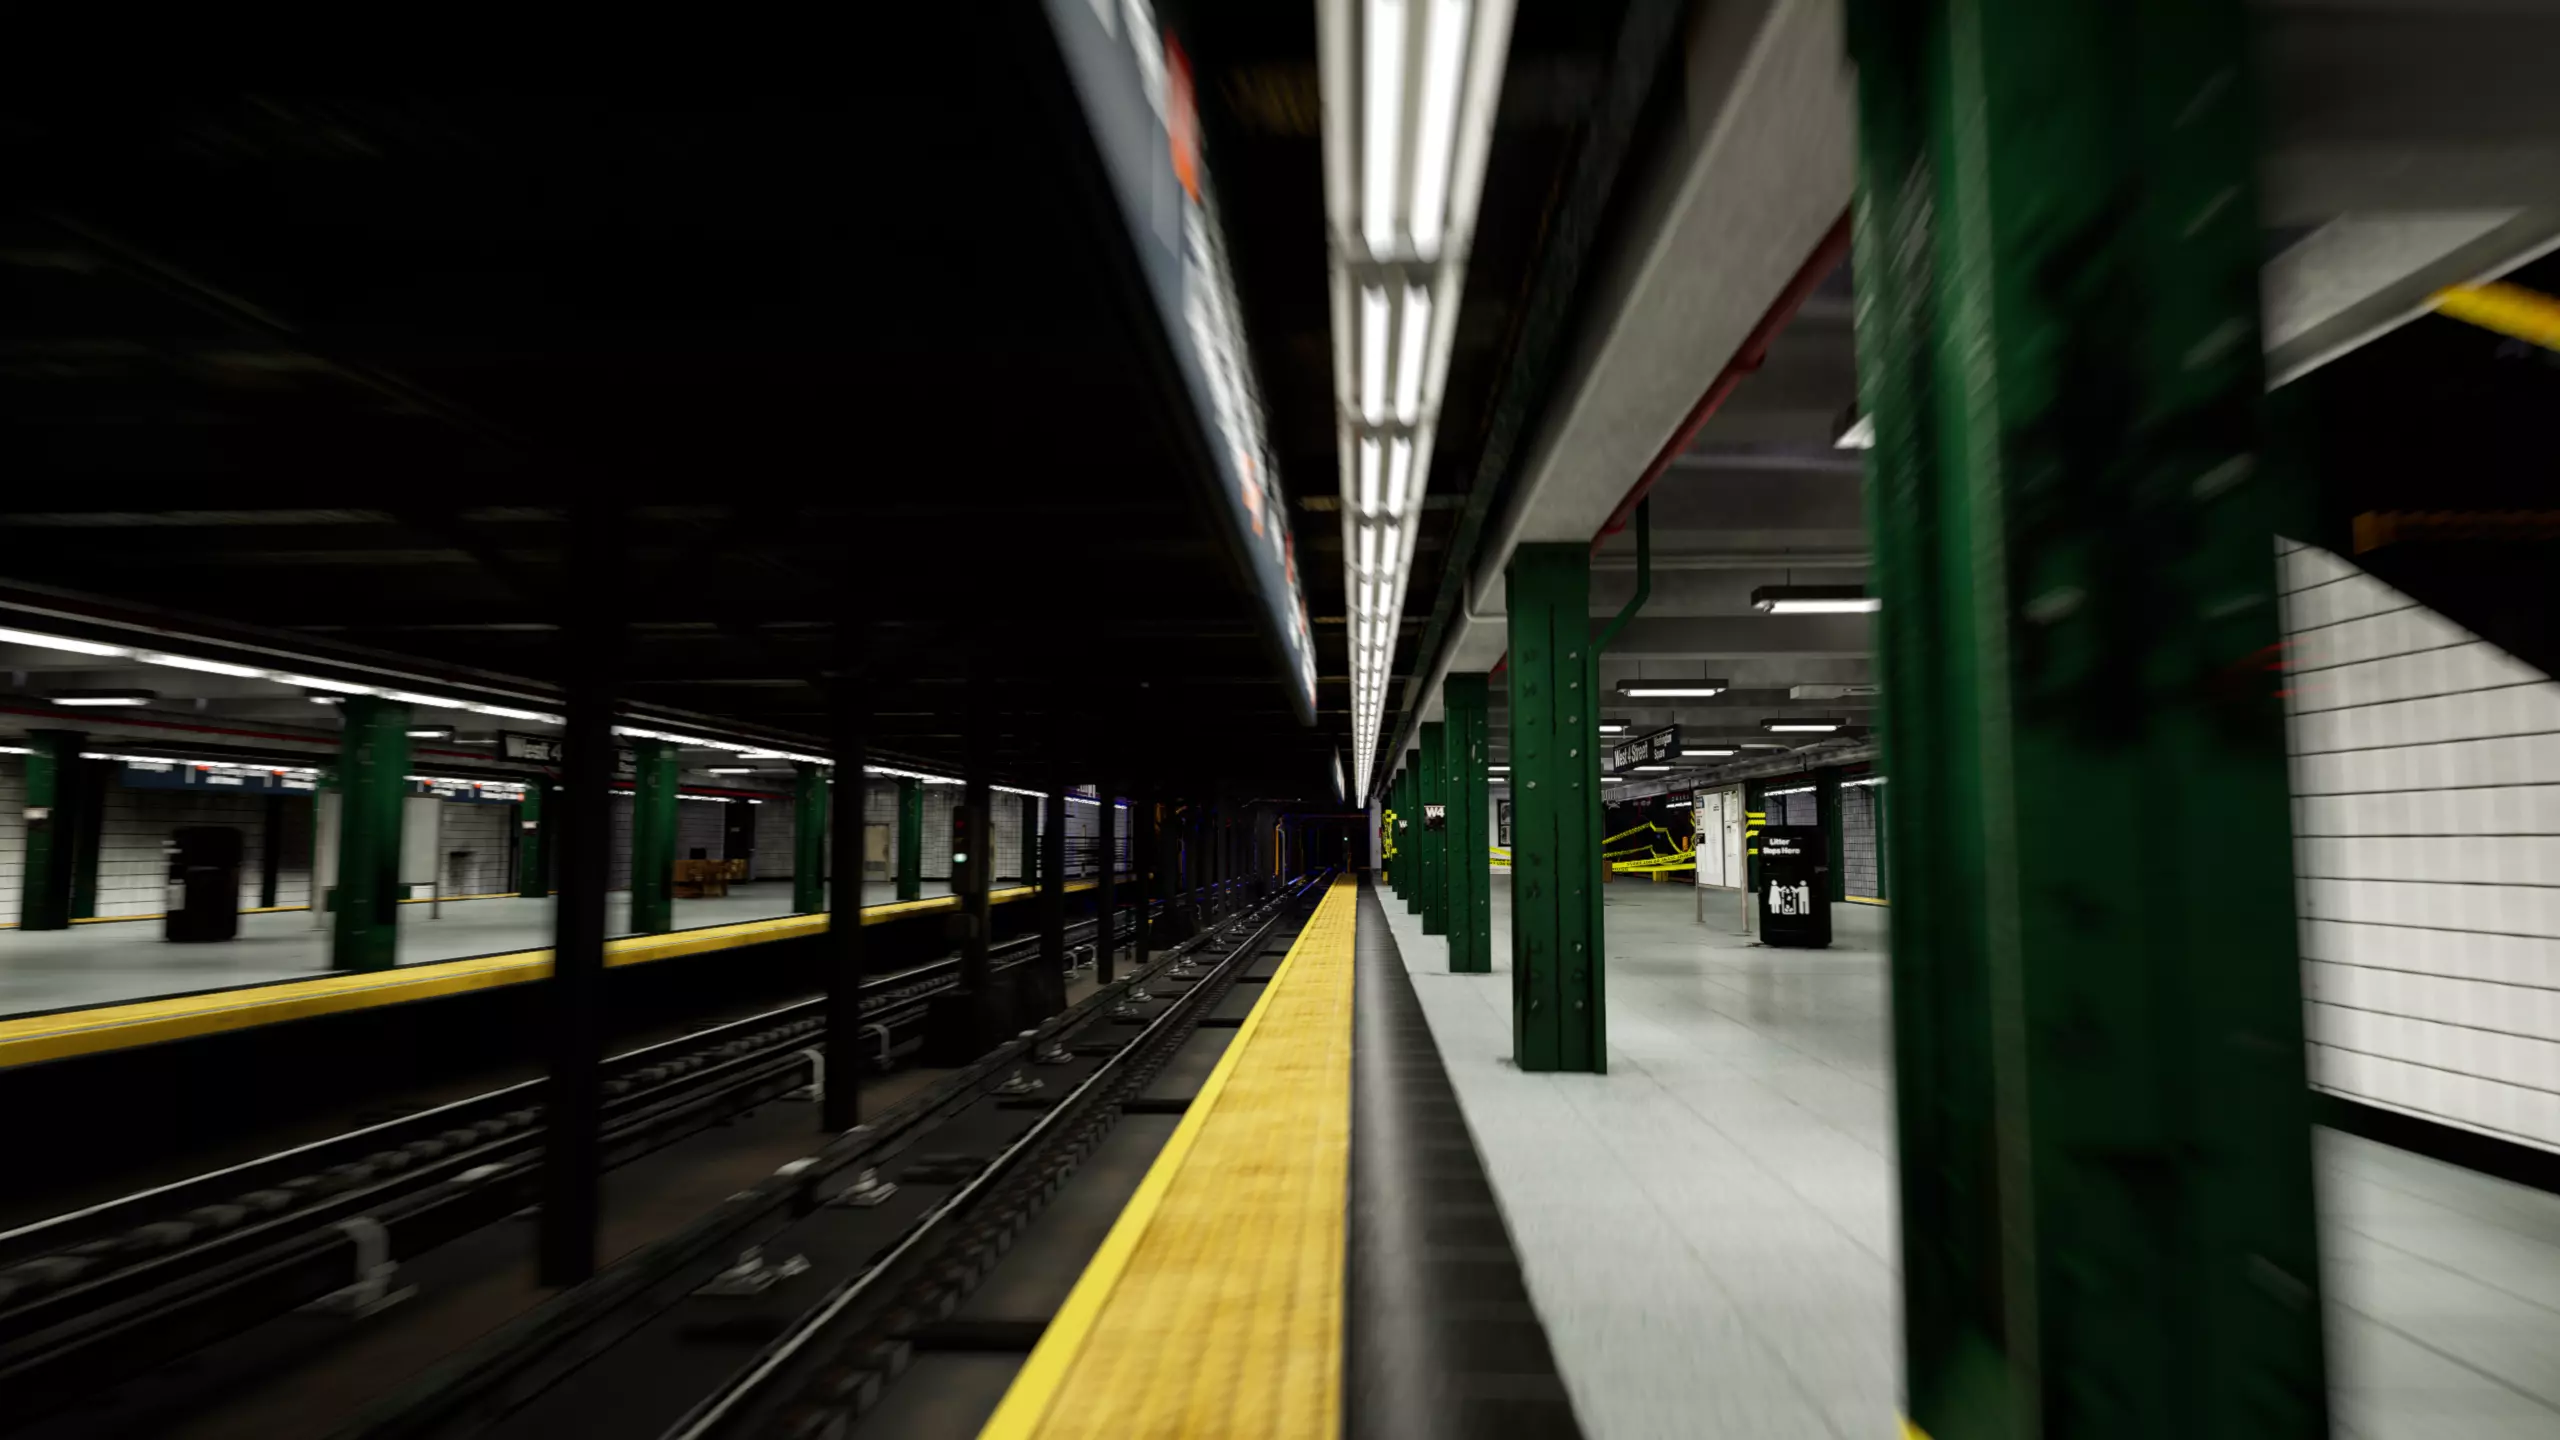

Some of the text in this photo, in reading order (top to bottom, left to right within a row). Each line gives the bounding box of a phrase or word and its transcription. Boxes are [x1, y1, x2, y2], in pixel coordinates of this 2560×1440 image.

[1614, 747, 1628, 768] West
[1631, 741, 1648, 762] Street
[1425, 807, 1445, 818] W4
[1769, 838, 1790, 846] Litter
